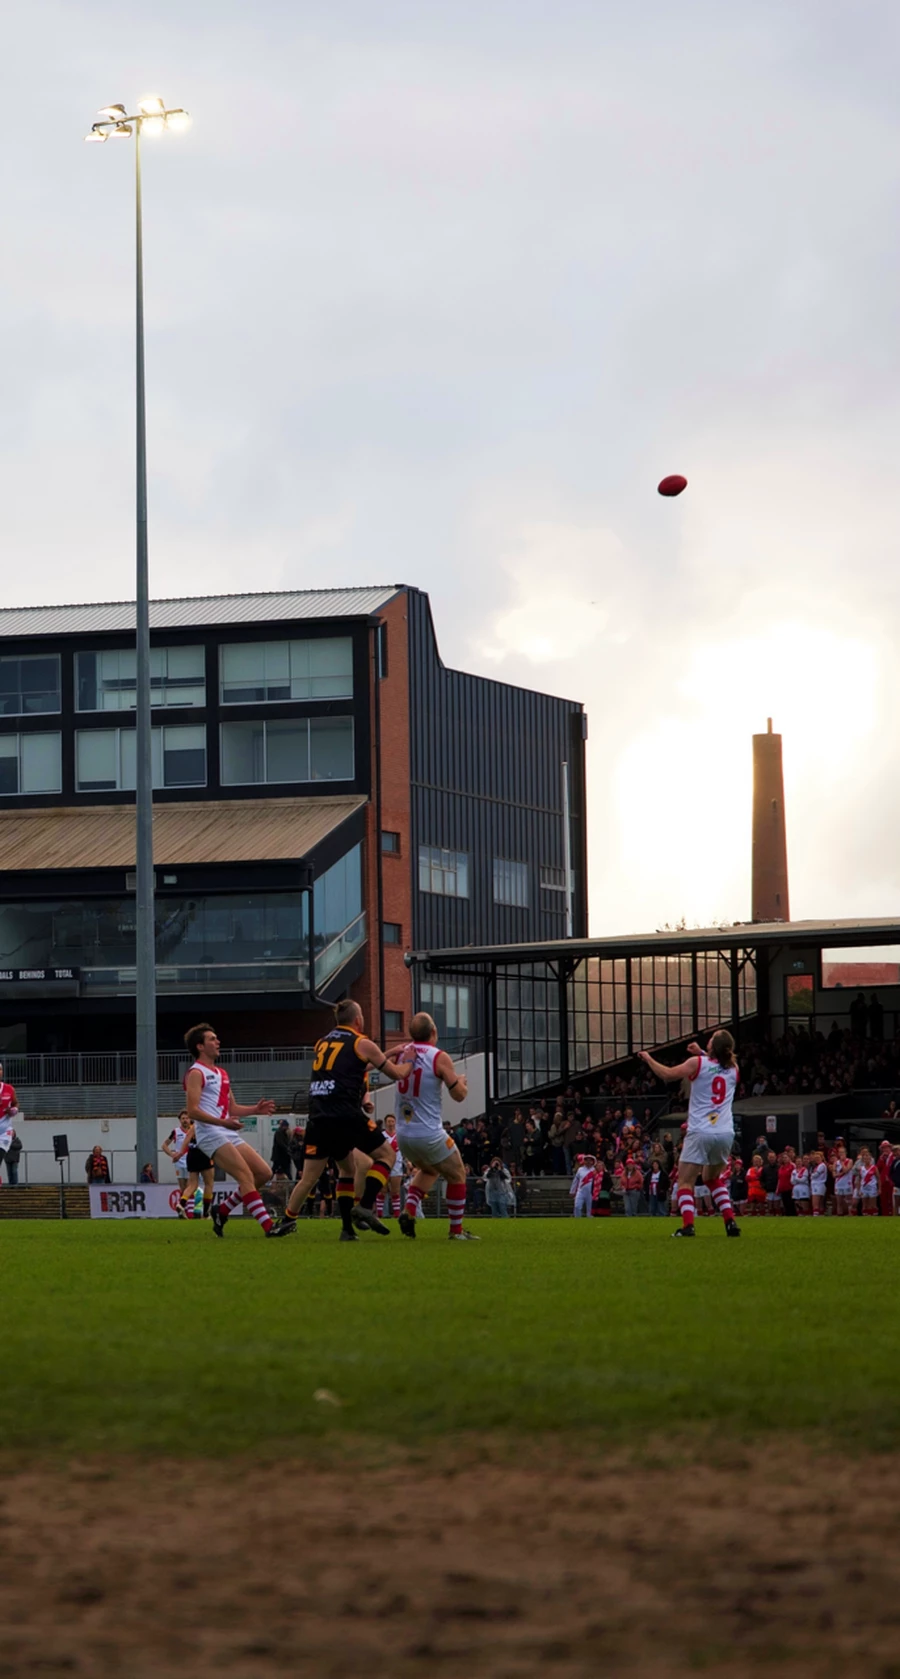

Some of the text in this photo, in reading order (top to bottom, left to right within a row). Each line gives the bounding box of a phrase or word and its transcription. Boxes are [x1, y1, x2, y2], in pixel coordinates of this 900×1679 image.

[19, 970, 45, 979] BEHINDS
[55, 969, 73, 978] TOTAL
[312, 1041, 345, 1071] 37
[710, 1075, 727, 1105] 9
